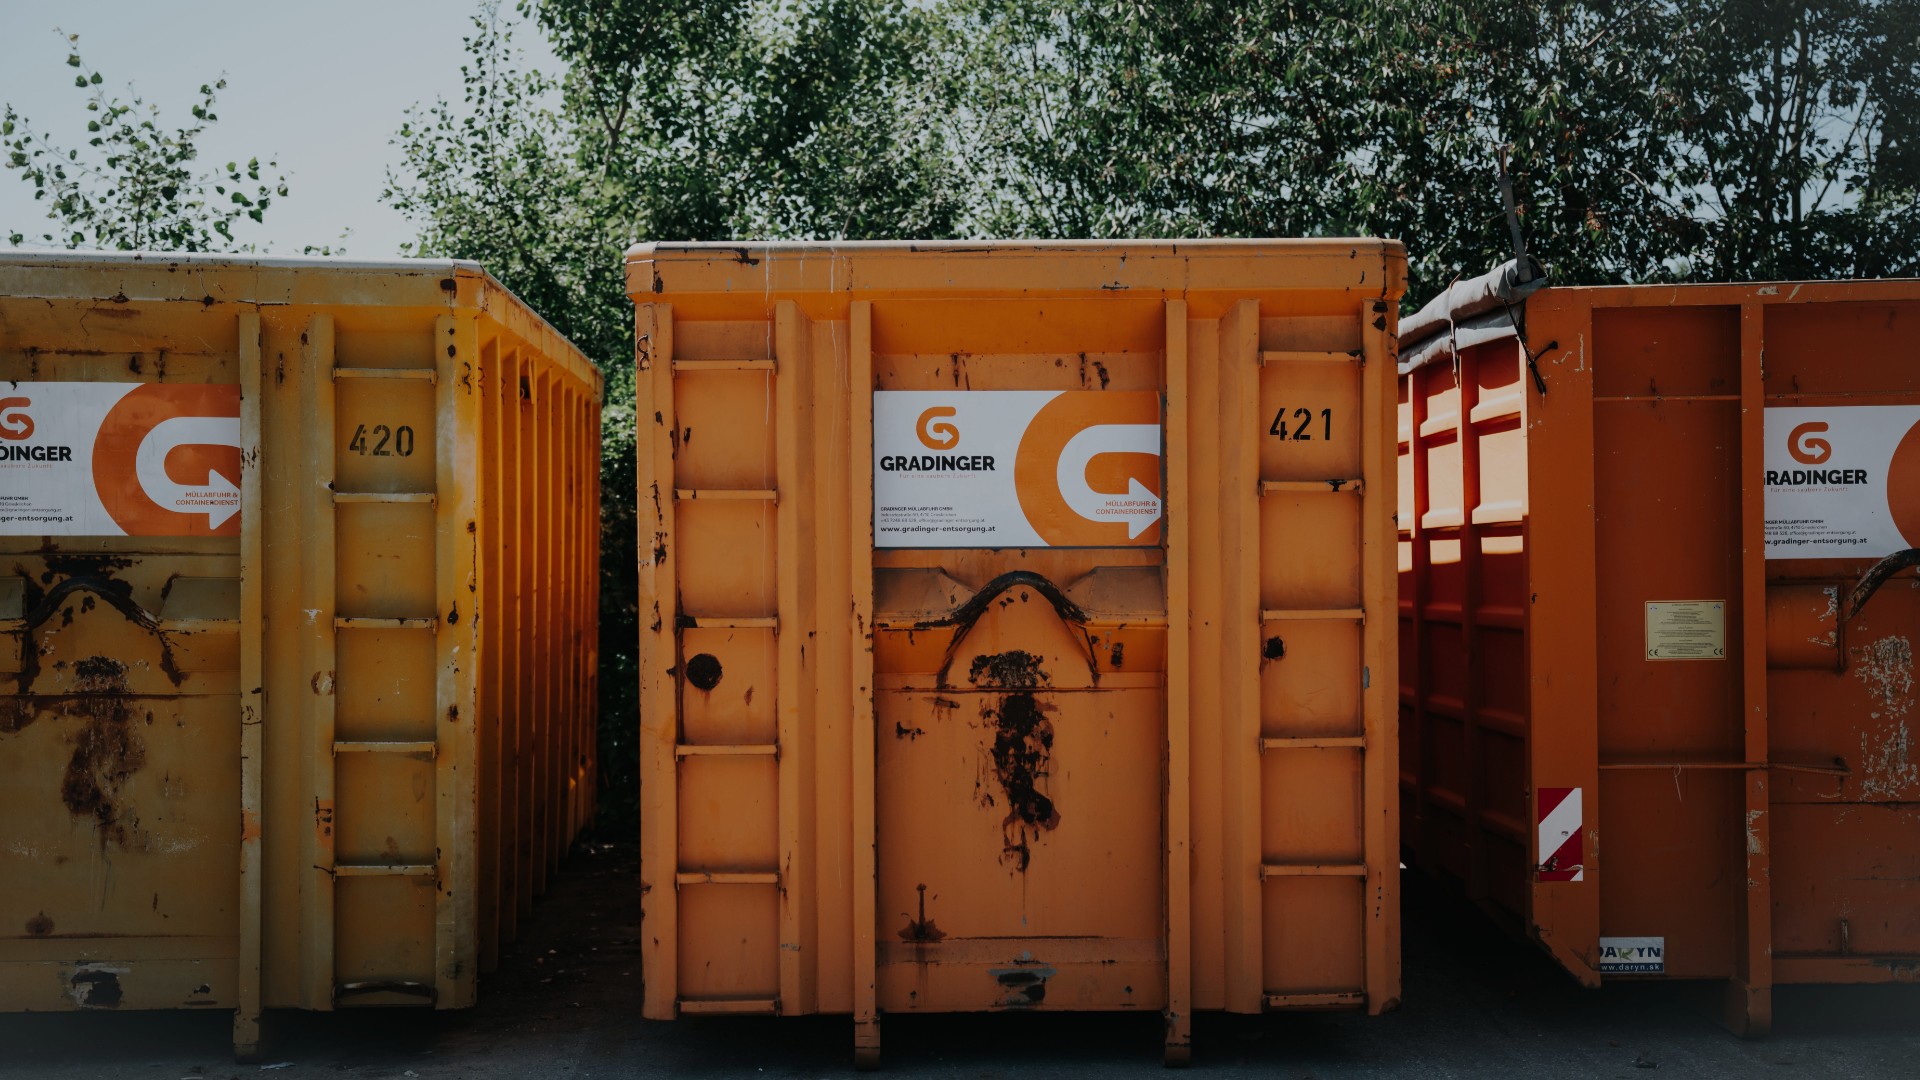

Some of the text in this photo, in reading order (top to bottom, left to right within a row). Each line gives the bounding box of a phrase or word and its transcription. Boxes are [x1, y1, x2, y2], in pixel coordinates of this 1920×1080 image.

[1270, 408, 1331, 441] 421
[349, 424, 414, 457] 420
[880, 456, 995, 471] GRADINGER
[1764, 470, 1867, 485] RADINGER
[185, 490, 231, 498] MÜLLABFUHR
[880, 525, 995, 534] www.gradinger-entsorgung.at
